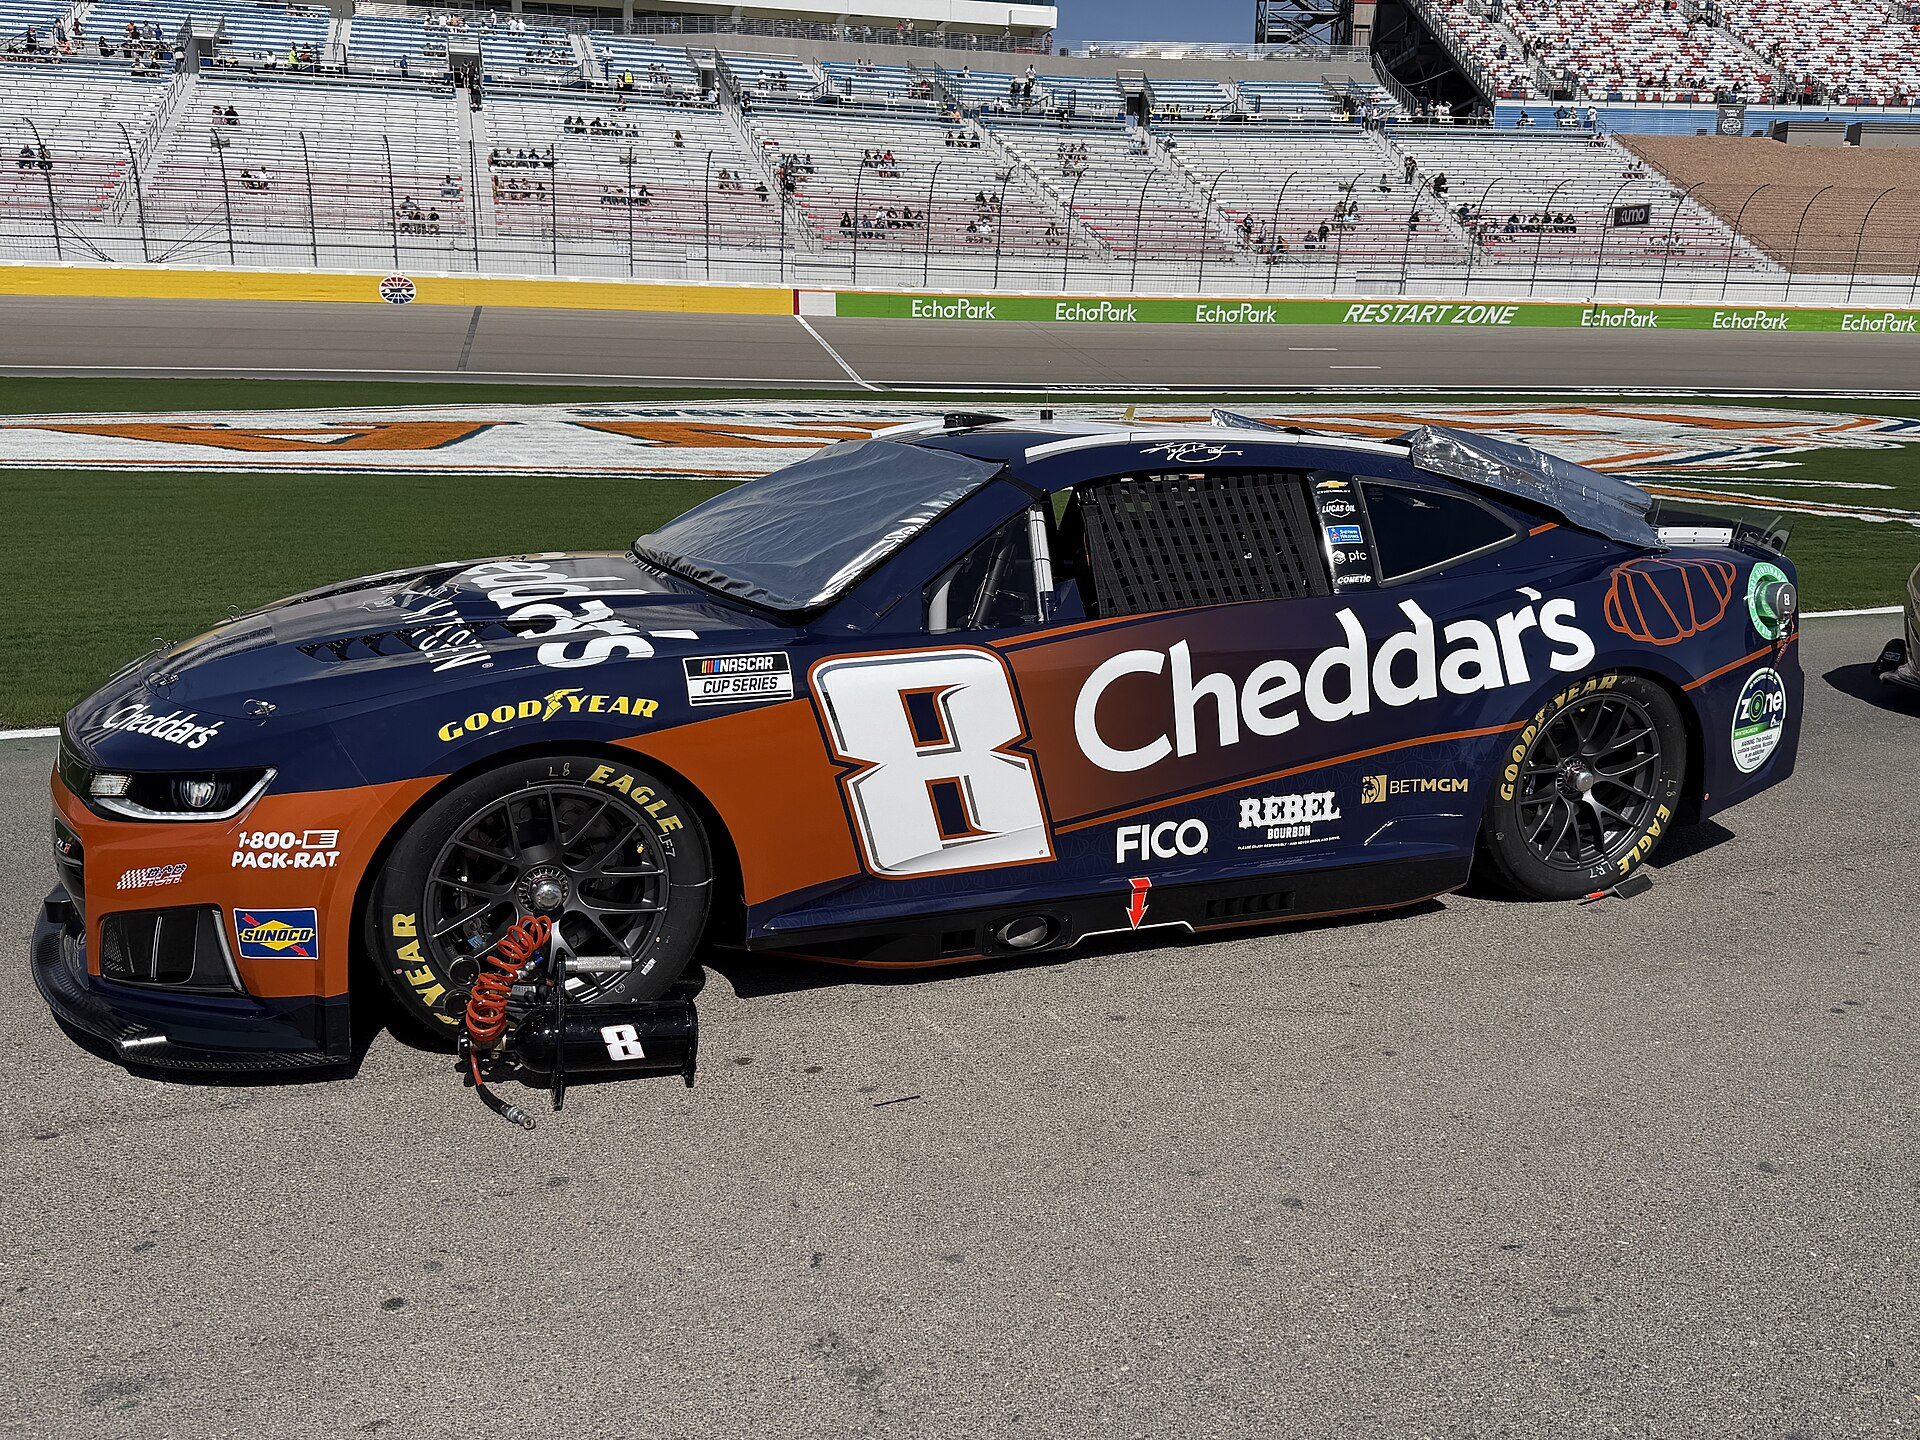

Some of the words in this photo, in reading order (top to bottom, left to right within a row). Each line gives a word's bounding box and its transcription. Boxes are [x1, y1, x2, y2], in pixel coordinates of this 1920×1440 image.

[911, 298, 996, 320] EchoPark
[1055, 301, 1138, 322] EchoPark
[1195, 303, 1278, 323] EchoPark
[1343, 304, 1452, 323] RESTART
[1450, 306, 1519, 324] ZONE
[1581, 307, 1659, 327] EchoPark
[1712, 310, 1788, 330] EchoPark
[1841, 313, 1918, 332] EchoPark
[1322, 504, 1344, 514] LUCAS
[1345, 504, 1356, 513] OIL
[1348, 550, 1367, 563] ptc
[462, 561, 700, 668] eddar's
[719, 656, 774, 673] NASCAR
[703, 680, 731, 694] CUP
[732, 676, 779, 692] SERIES
[1074, 587, 1595, 772] Cheddar's
[102, 703, 225, 749] Cheddar's
[809, 647, 1053, 878] 8
[1389, 778, 1469, 794] BETMGM
[587, 764, 683, 833] EAGLE
[1238, 790, 1341, 829] REBEL
[1116, 818, 1208, 863] FICO
[1267, 824, 1311, 840] BOURBON
[1616, 803, 1671, 876] EAGLE
[231, 851, 340, 869] PACK-RAT
[242, 928, 313, 942] SUNOCO
[392, 912, 447, 1007] YEAR
[600, 1024, 645, 1061] 8
